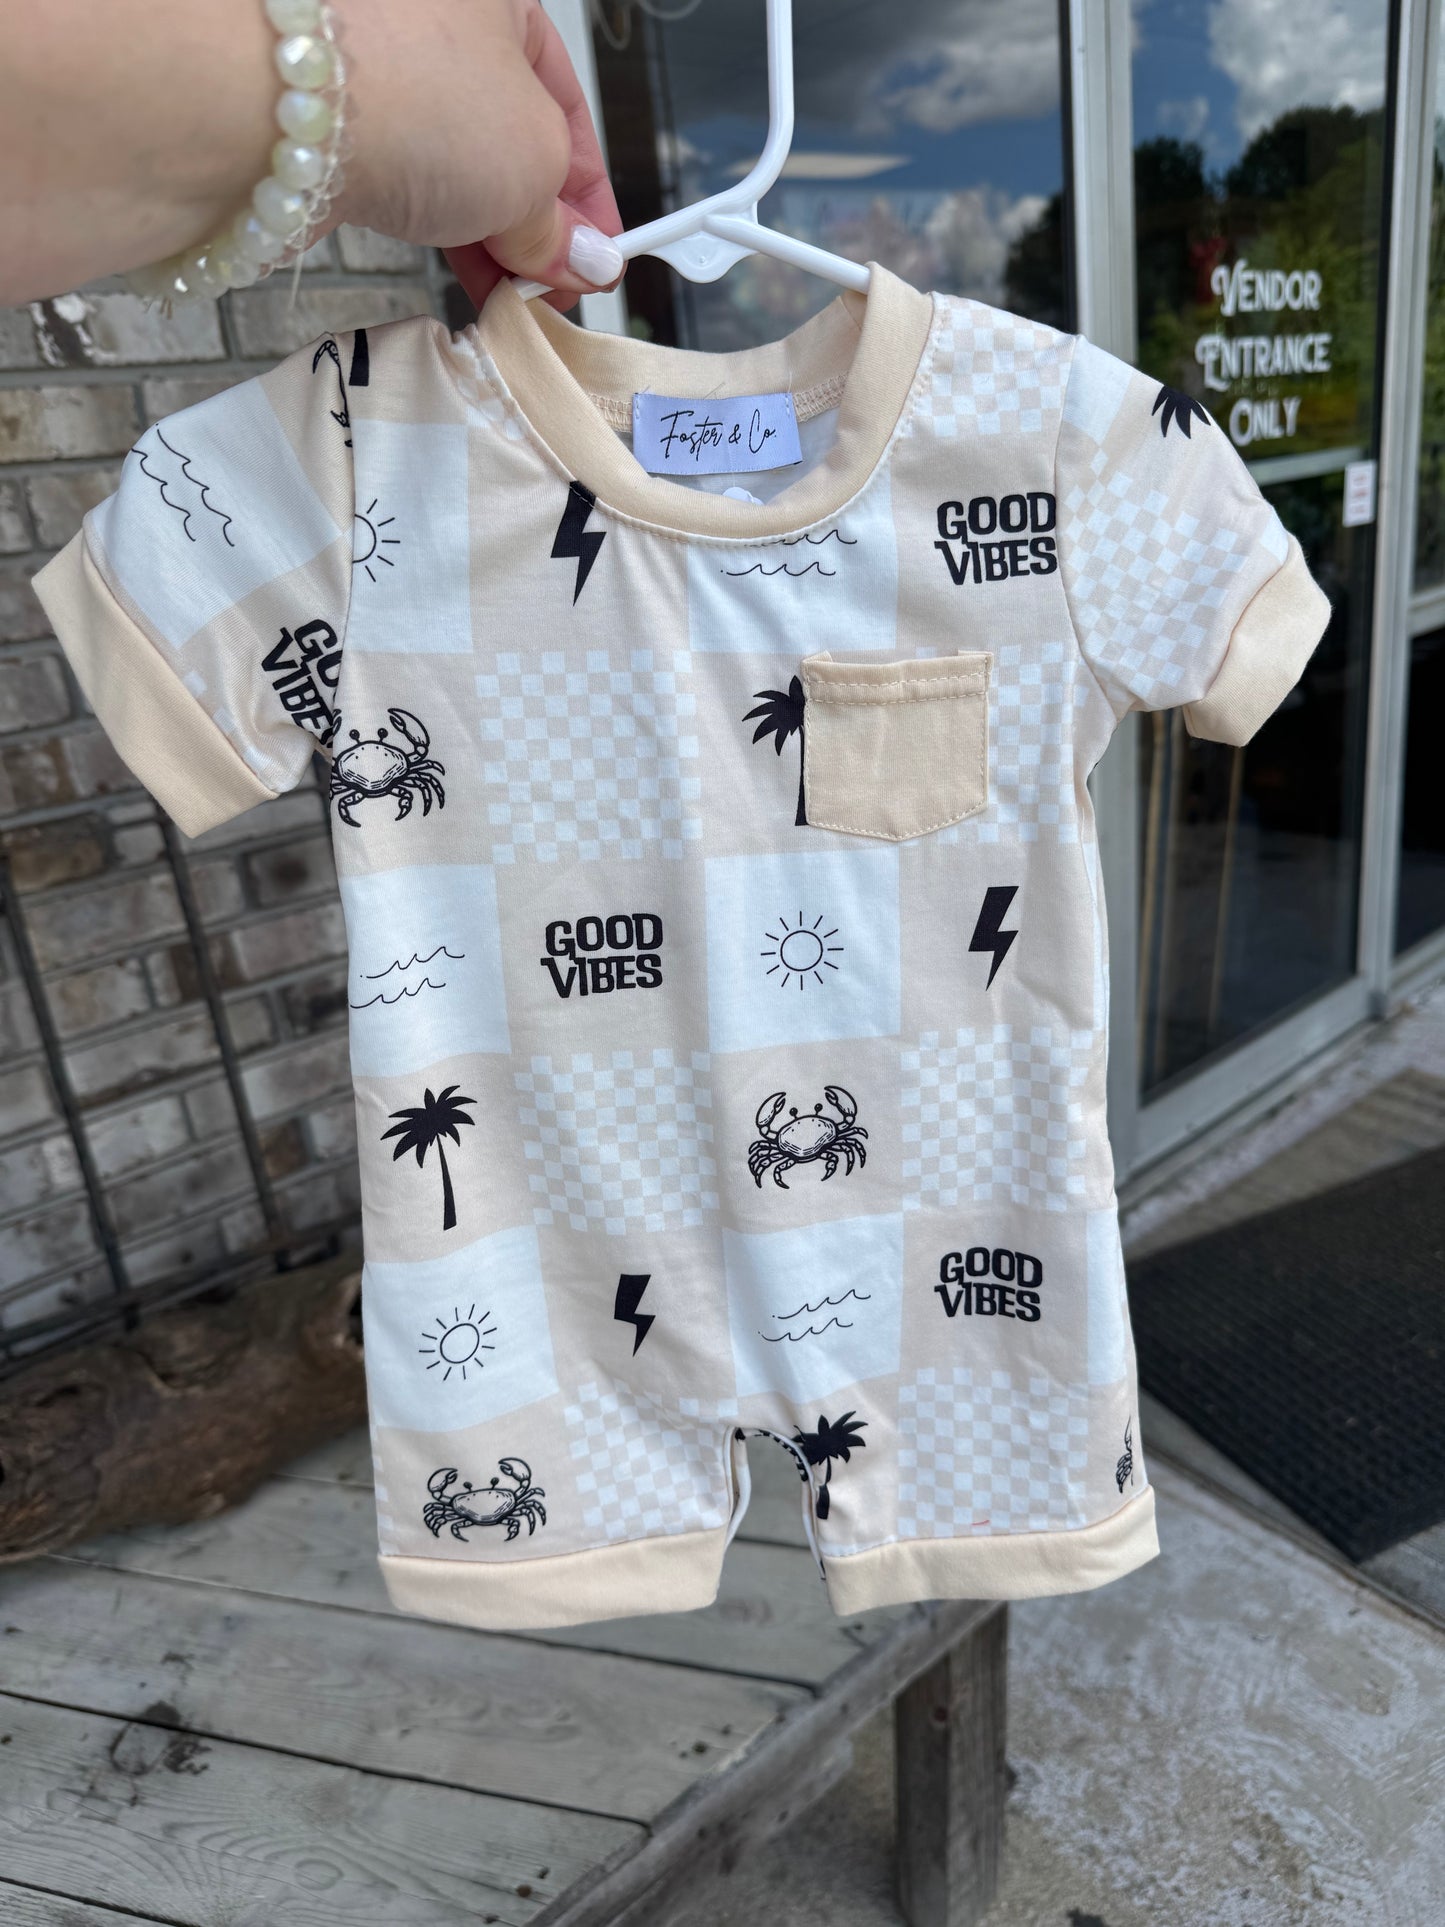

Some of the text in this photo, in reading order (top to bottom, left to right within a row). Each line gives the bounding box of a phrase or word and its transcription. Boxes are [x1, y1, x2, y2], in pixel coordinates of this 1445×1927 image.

[1211, 258, 1322, 316] VENDOR
[1195, 332, 1332, 392] ENTRANCE
[660, 410, 723, 461] Foster
[728, 423, 741, 444] &
[1229, 396, 1301, 446] ONLY
[937, 492, 1057, 544] GOOD
[934, 536, 1058, 586] VIBES
[545, 913, 663, 960] GOOD
[540, 953, 663, 998] VIBES
[940, 1246, 1042, 1288] GOOD
[934, 1281, 1041, 1322] VIBES
